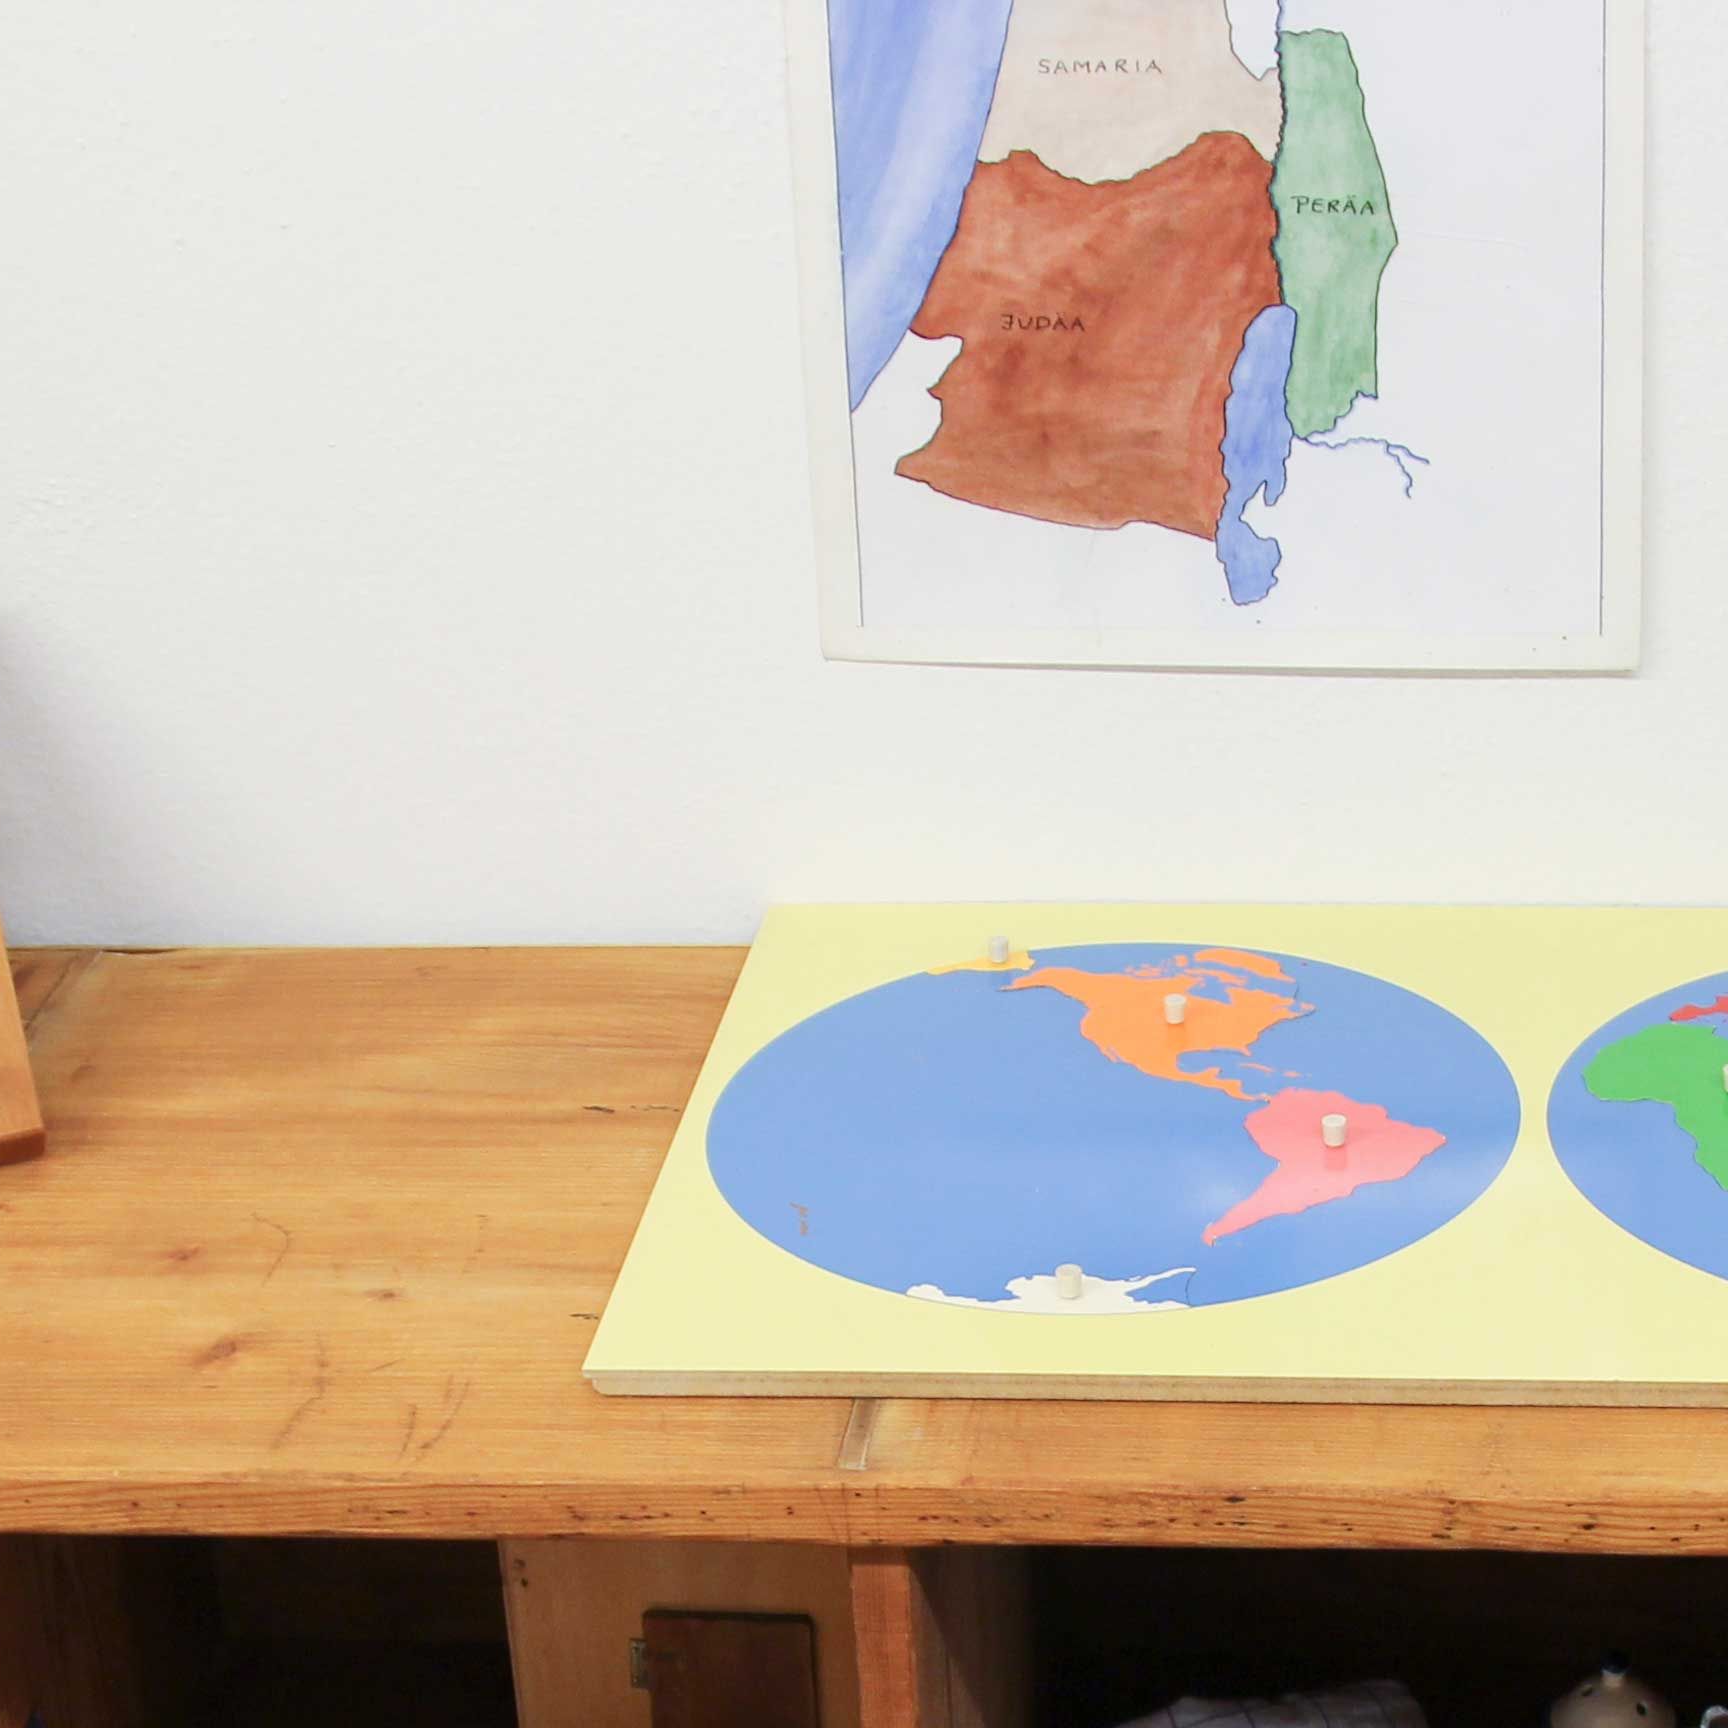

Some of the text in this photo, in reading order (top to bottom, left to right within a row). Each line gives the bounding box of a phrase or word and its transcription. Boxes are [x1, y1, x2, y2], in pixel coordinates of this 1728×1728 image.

[1036, 57, 1164, 75] SAMARIA
[1290, 193, 1376, 216] PERÄA
[1000, 313, 1087, 332] JUDÄA
